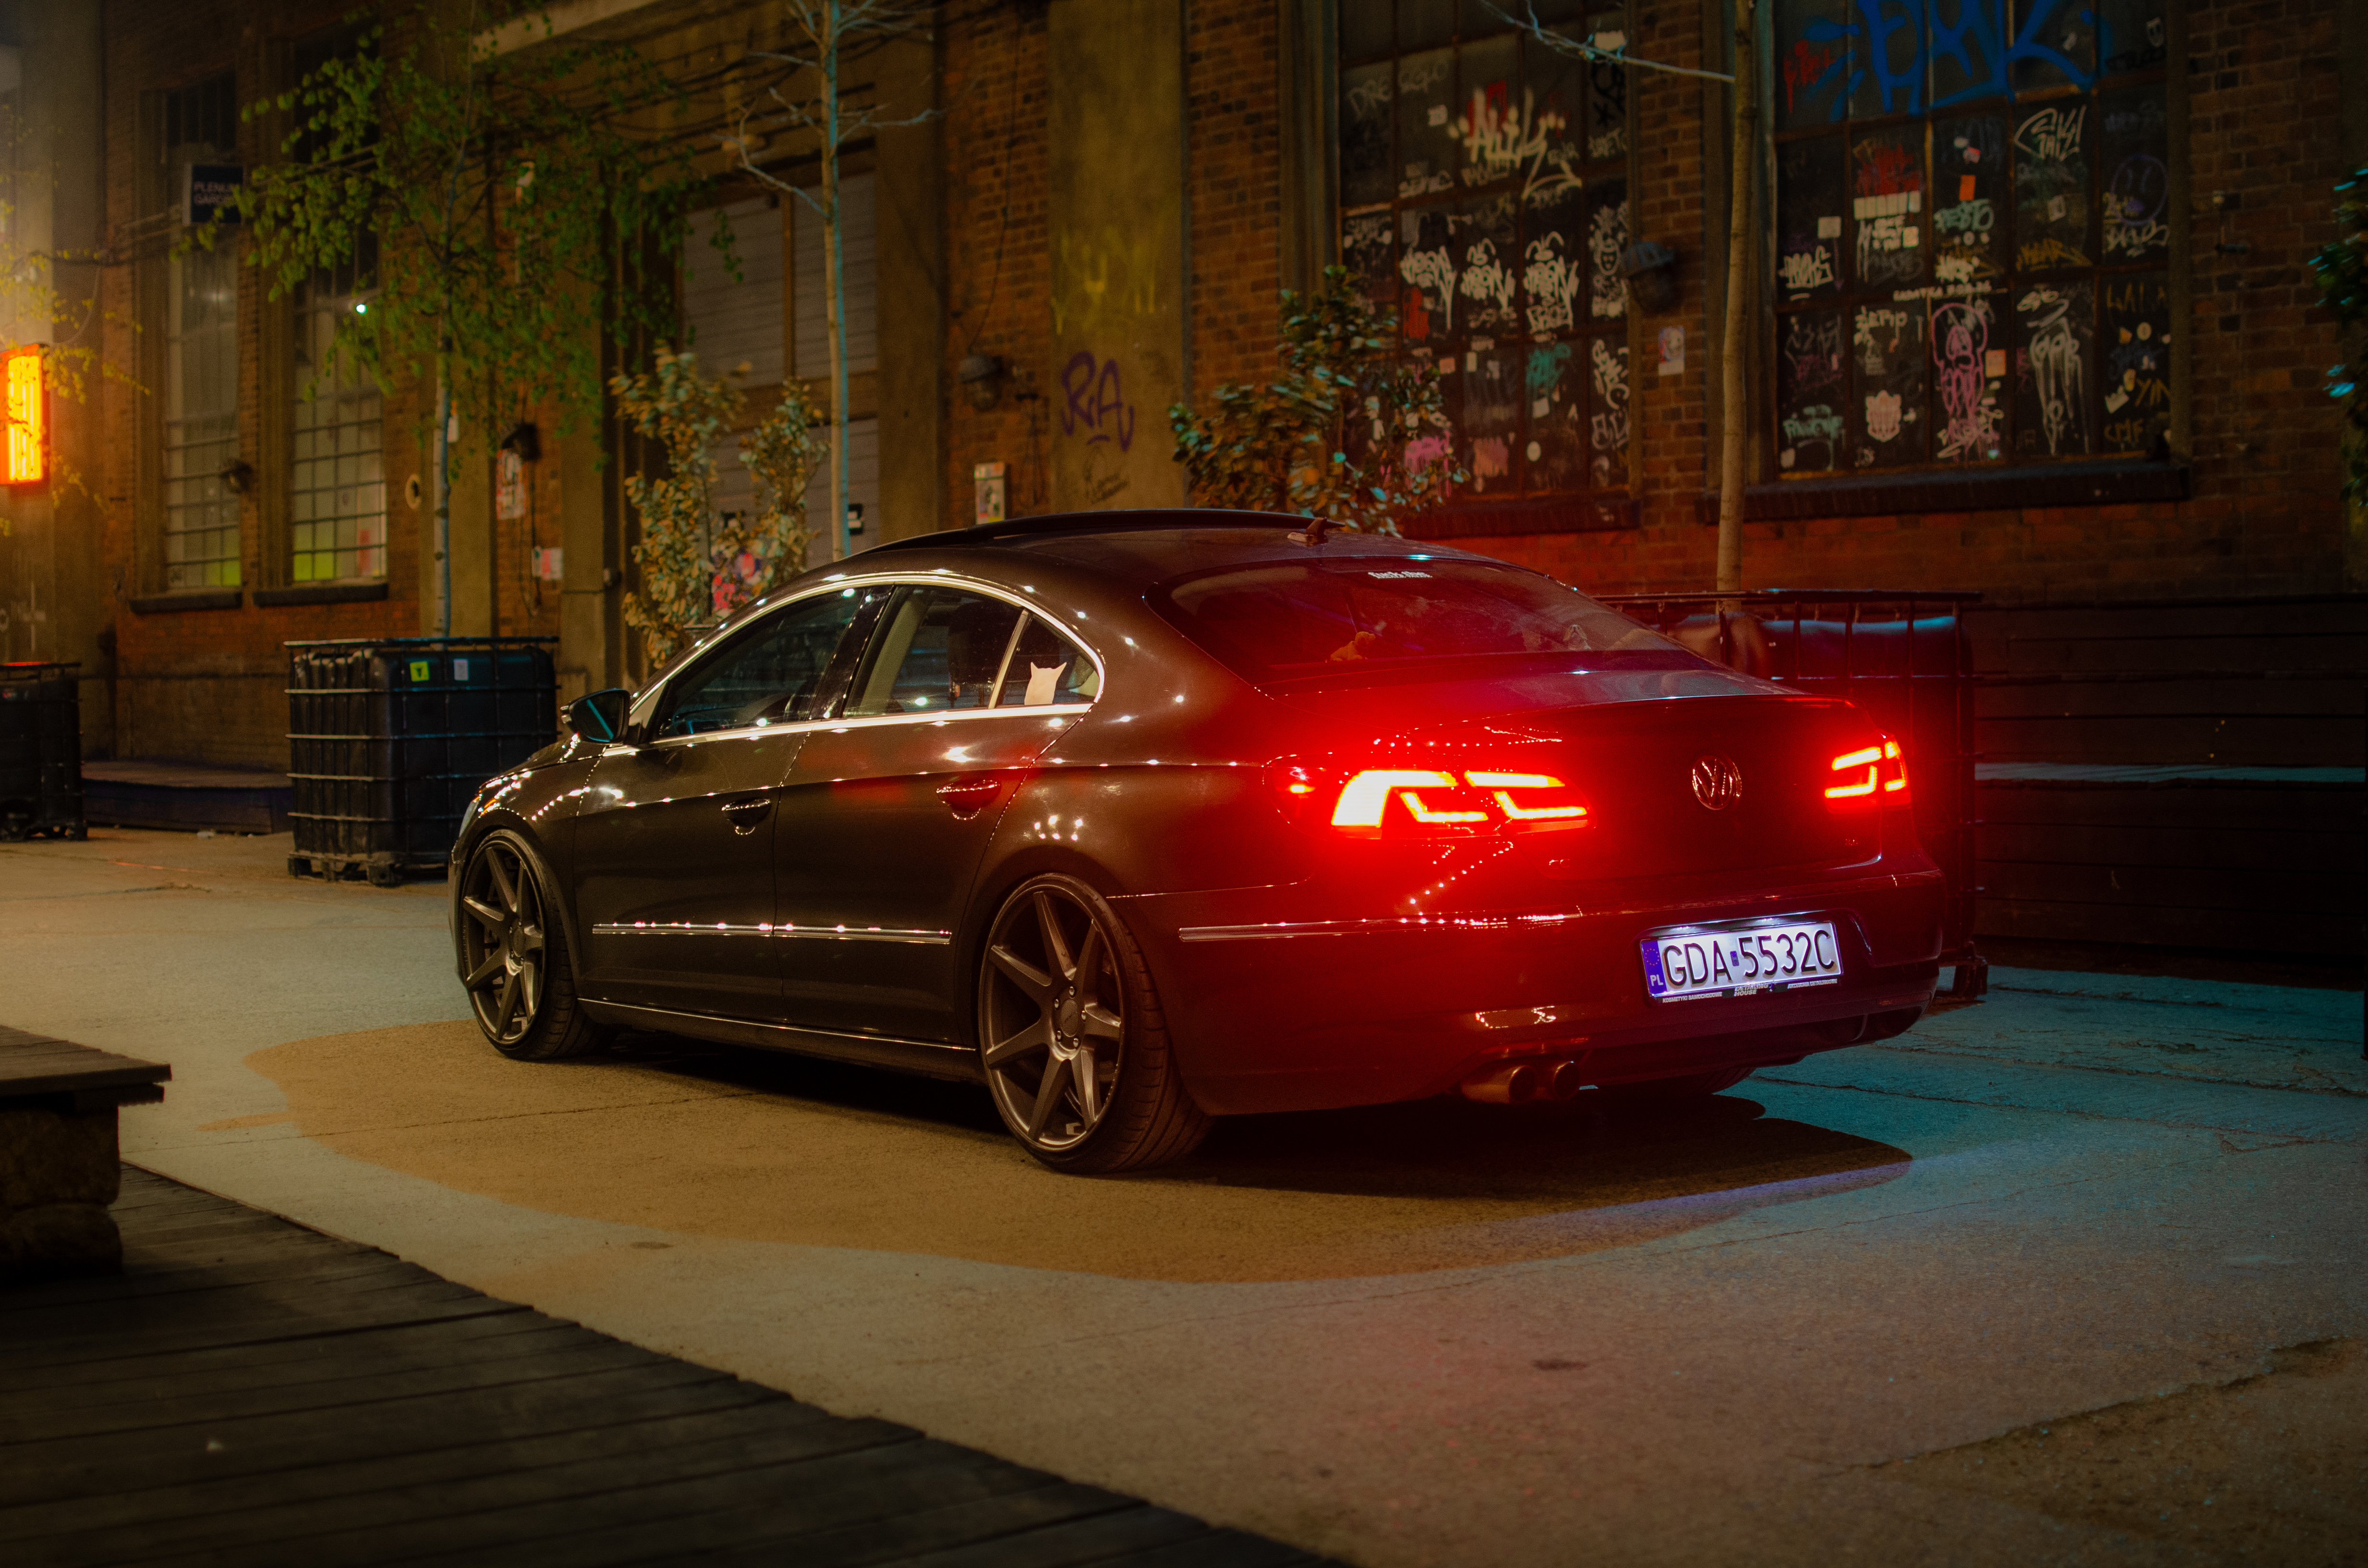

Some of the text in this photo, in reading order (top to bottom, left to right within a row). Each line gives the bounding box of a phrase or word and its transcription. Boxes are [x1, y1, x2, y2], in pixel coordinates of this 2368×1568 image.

[1663, 930, 1836, 987] GDA 5532C
[1650, 974, 1663, 986] PL
[1734, 989, 1757, 997] HOUSE
